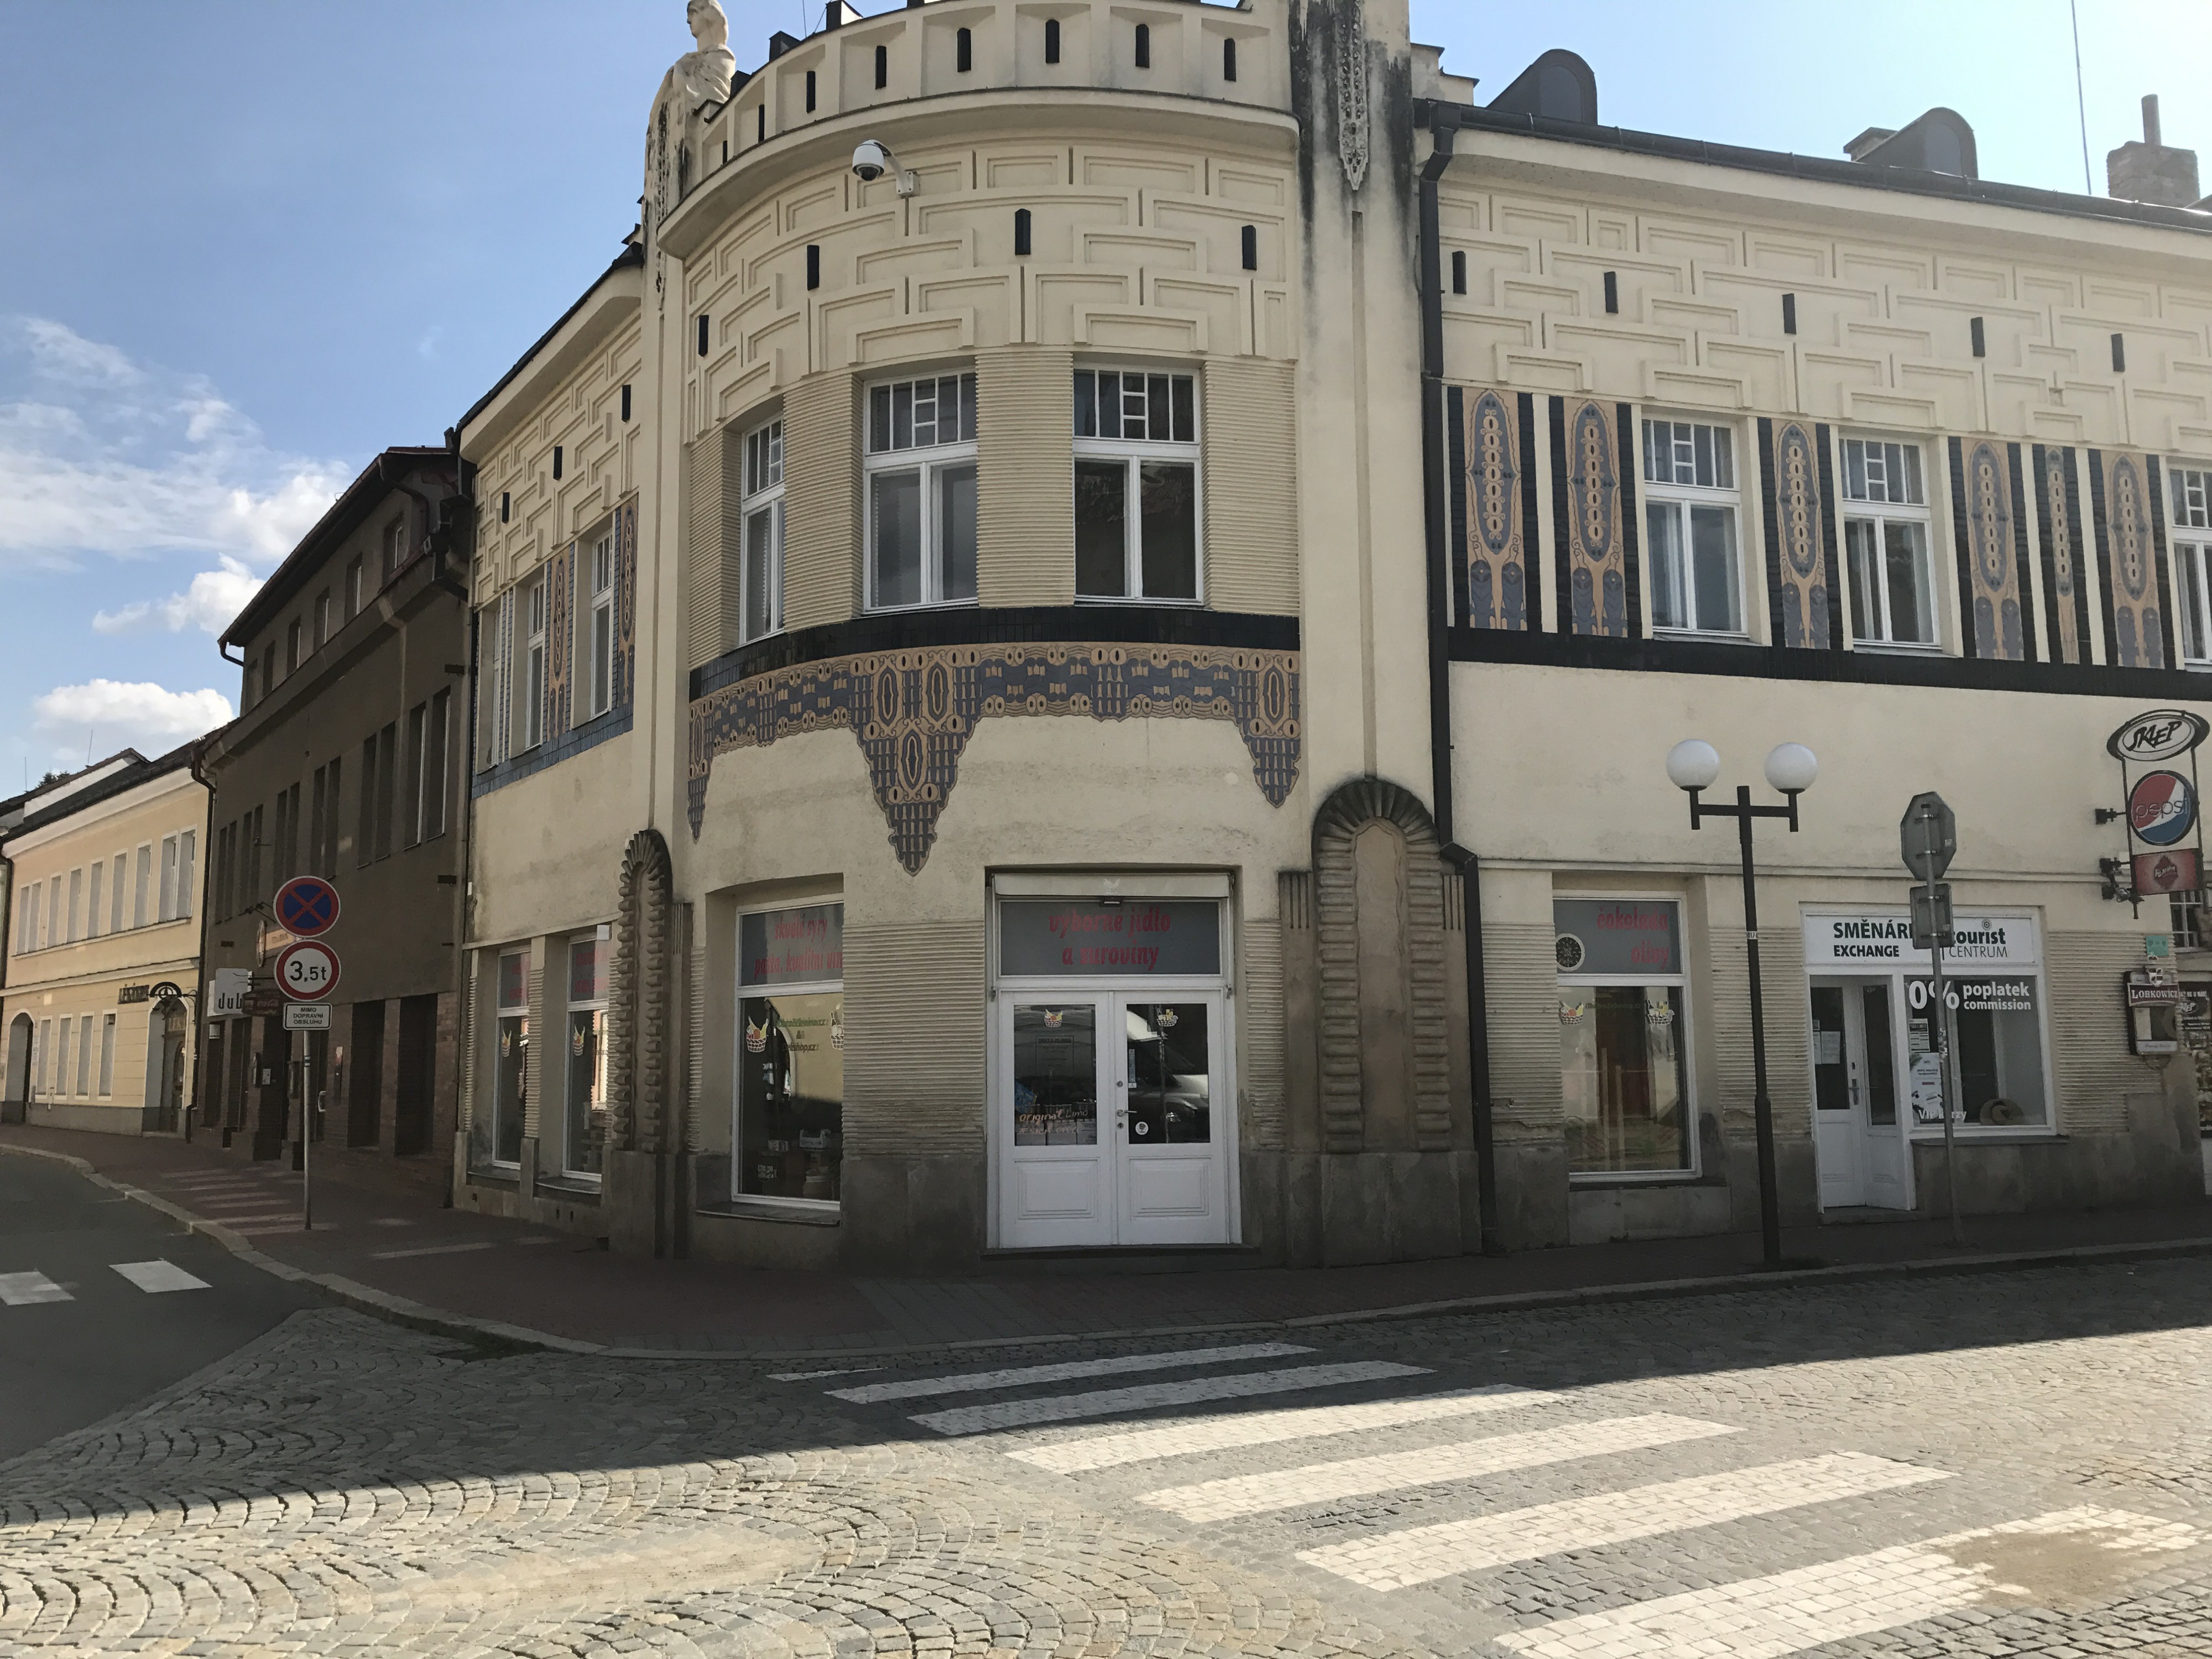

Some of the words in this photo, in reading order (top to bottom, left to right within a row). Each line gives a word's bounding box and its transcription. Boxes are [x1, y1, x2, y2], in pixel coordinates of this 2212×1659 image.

[2126, 721, 2182, 751] SKLEP
[2135, 798, 2188, 822] pepsi
[1833, 919, 1912, 939] SMĚNÁR
[1954, 928, 2006, 945] ourist
[1062, 947, 1073, 965] a
[1079, 938, 1159, 971] suroviny
[1833, 945, 1900, 957] EXCHANGE
[1949, 946, 2008, 958] CENTRUM
[1963, 981, 2030, 999] poplatek
[2131, 989, 2178, 999] LOBKOWICZ
[1964, 998, 2031, 1010] commission
[1918, 1109, 1937, 1120] VIP
[1938, 1108, 1967, 1121] krzy
